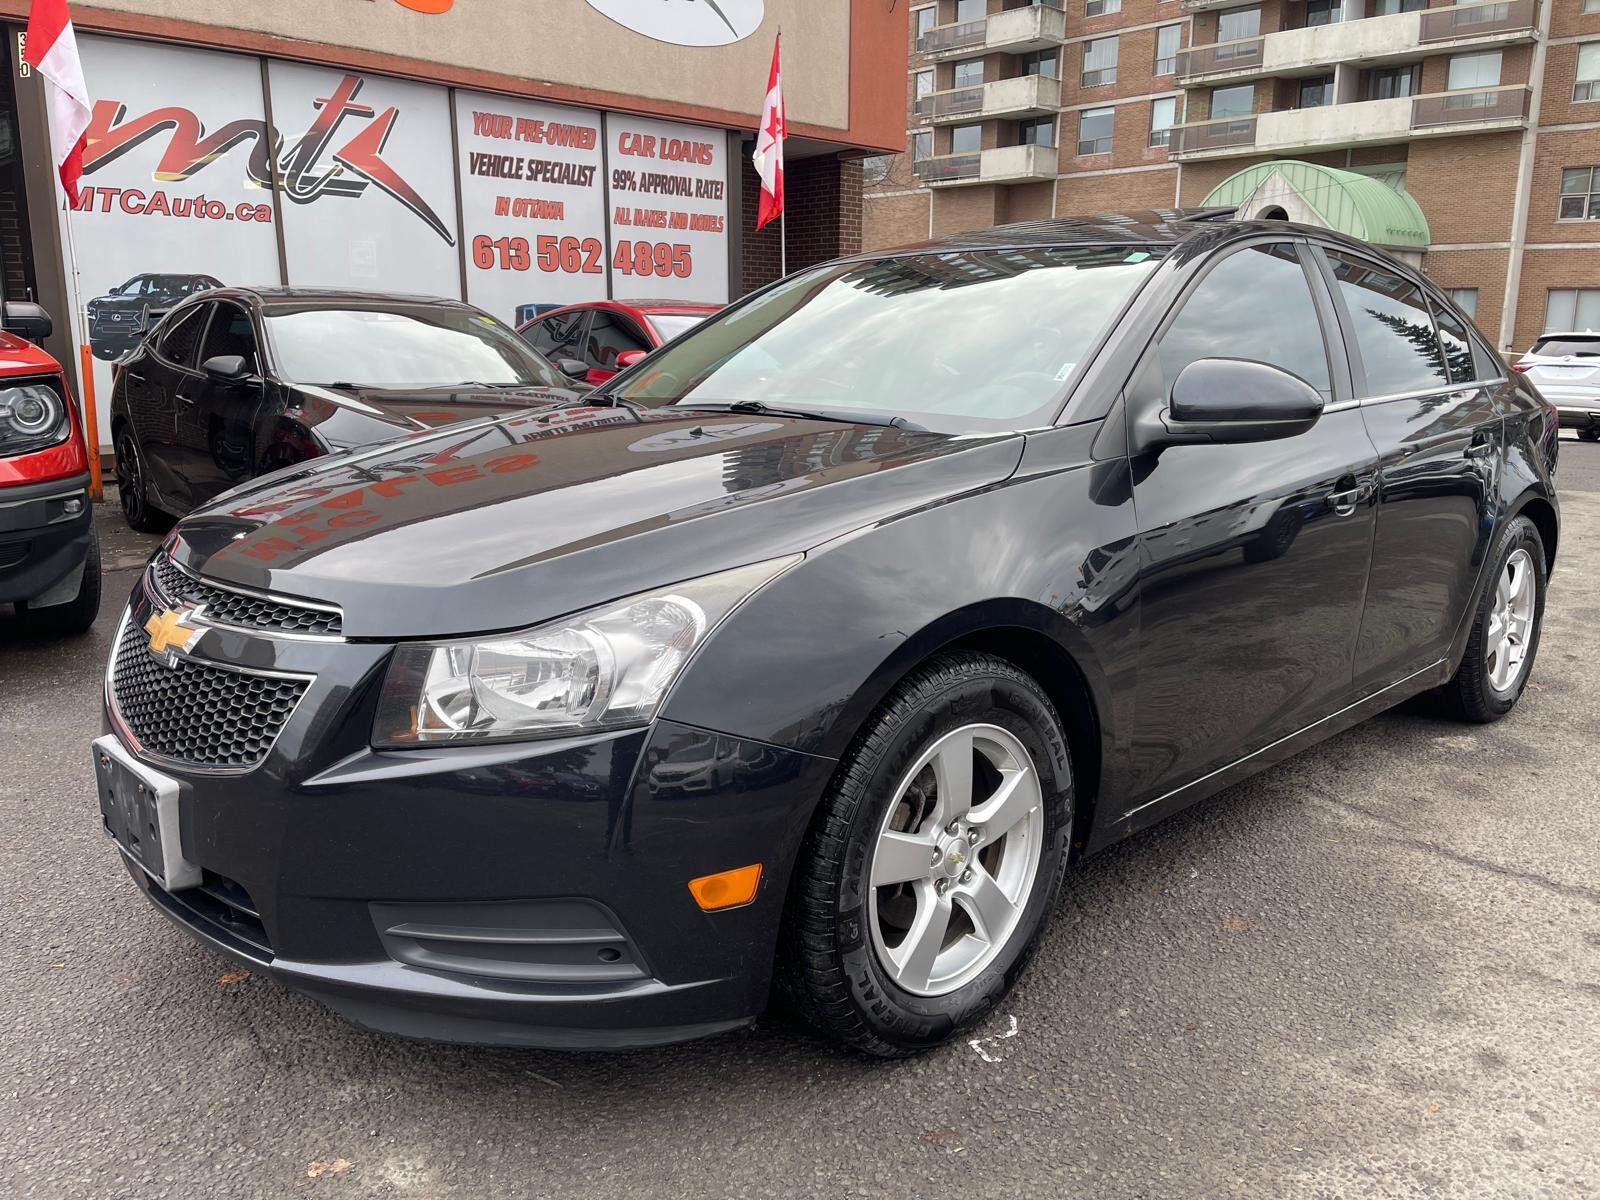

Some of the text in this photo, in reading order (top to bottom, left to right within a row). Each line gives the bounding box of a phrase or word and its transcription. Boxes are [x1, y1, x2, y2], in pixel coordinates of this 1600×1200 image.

[472, 111, 596, 150] YOUR PRE-OWNED
[618, 132, 713, 165] CAR LOANS
[469, 152, 596, 187] VEHICLE SPECIALIST
[612, 169, 724, 200] 99% APPROVAL RATE!
[63, 186, 272, 223] MTCAuto.ca
[495, 196, 564, 220] IN OTTAWA
[614, 207, 724, 233] ALL MAKES AND MODELS
[472, 234, 692, 278] 613 562 4895
